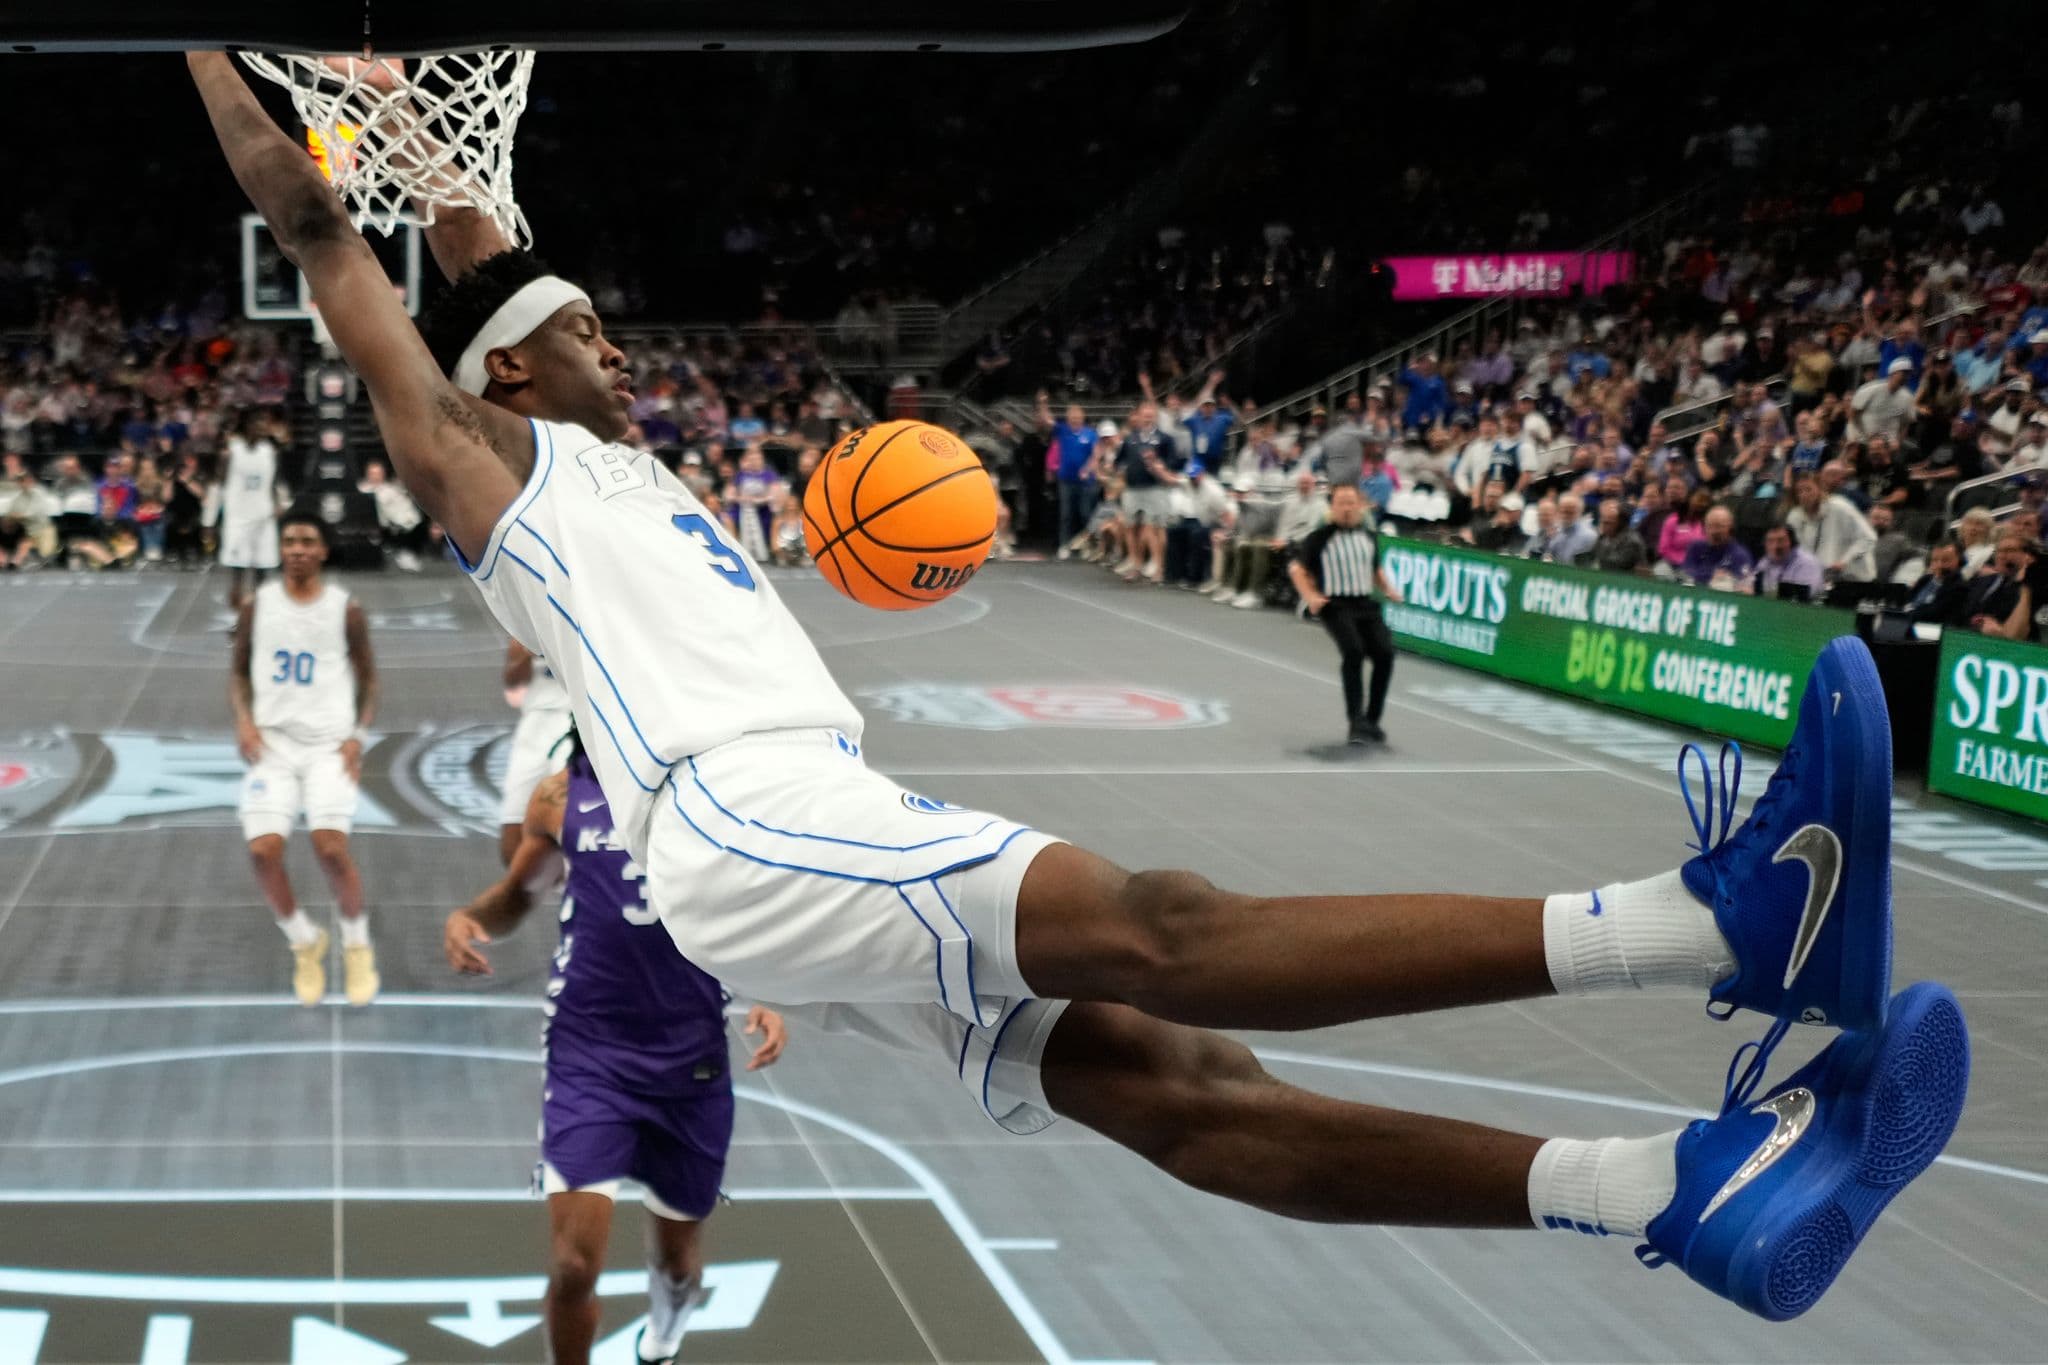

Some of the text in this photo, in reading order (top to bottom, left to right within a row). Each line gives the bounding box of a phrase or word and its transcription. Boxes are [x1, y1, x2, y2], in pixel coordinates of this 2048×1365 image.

[671, 513, 756, 592] 3
[911, 562, 975, 591] Wil
[1384, 548, 1510, 624] SPROUTS
[1522, 576, 1738, 646] OFFICIAL GROCER OF THE
[273, 650, 315, 685] 30
[1567, 627, 1791, 721] BIG 12 CONFERENCE
